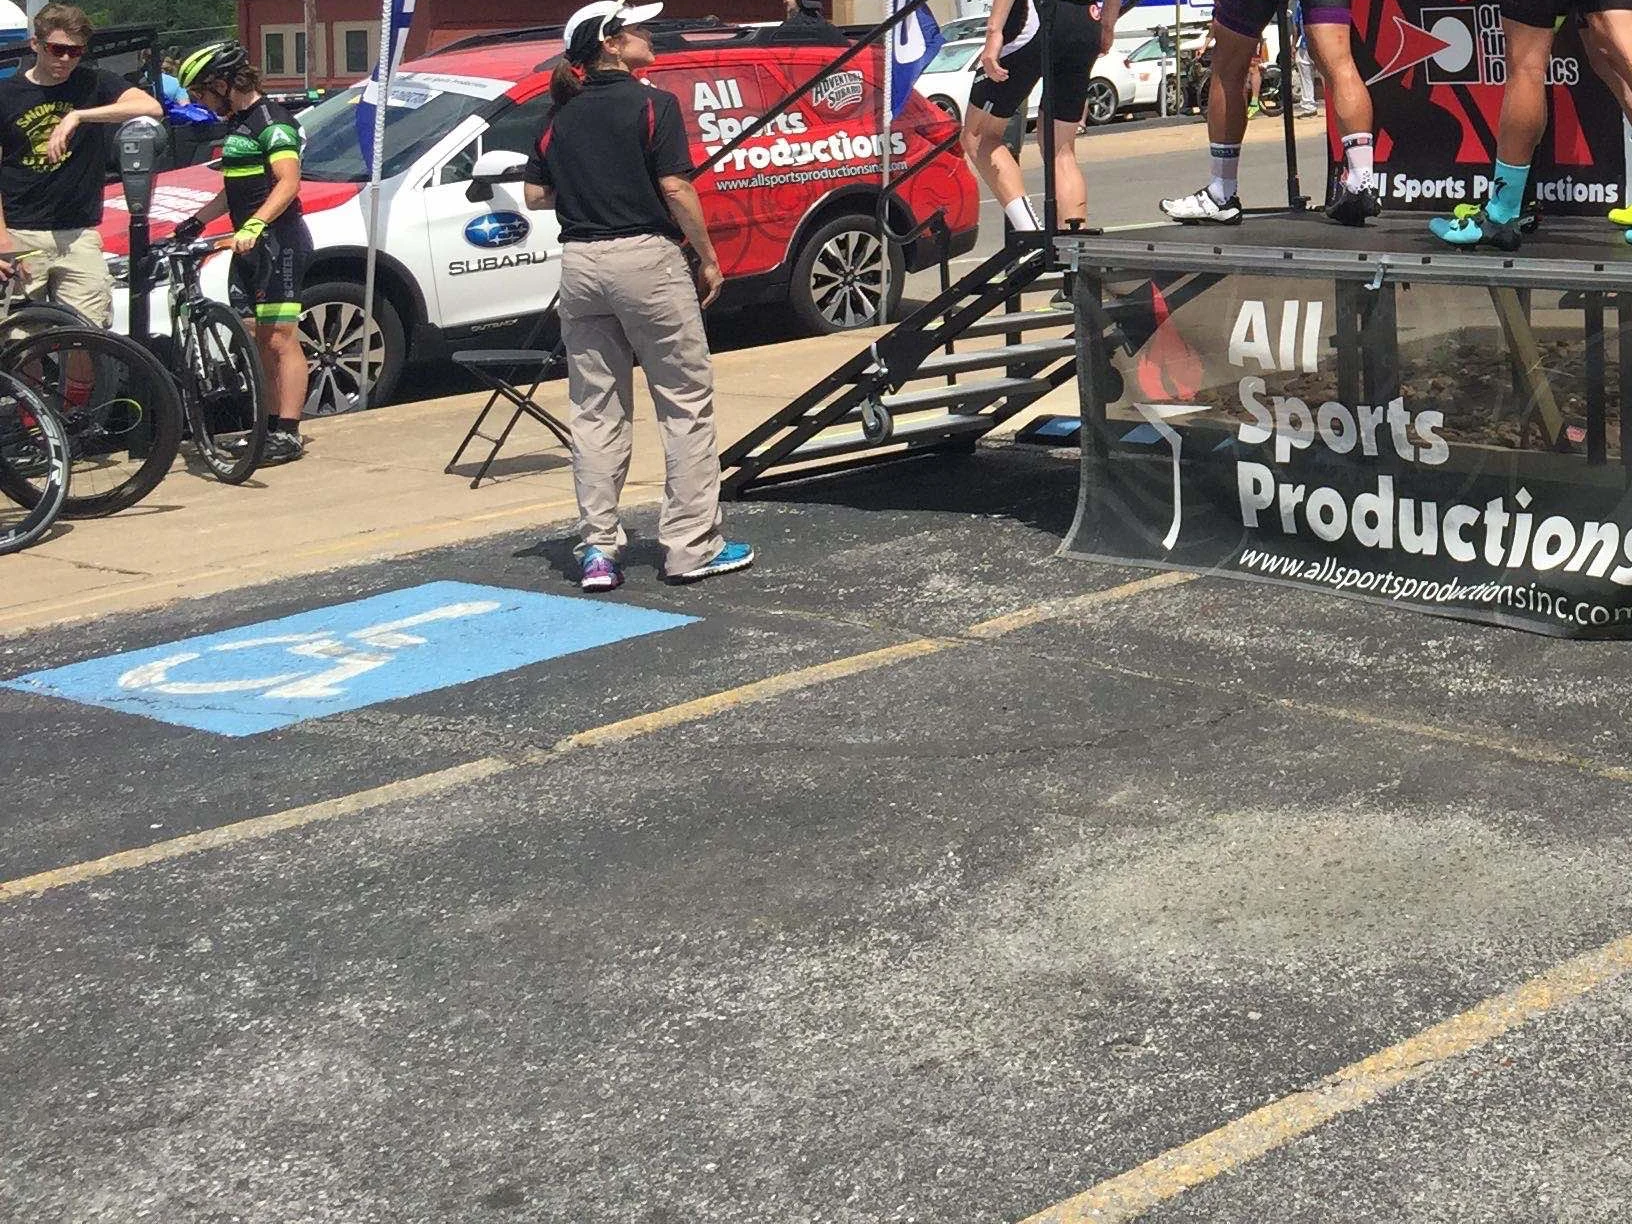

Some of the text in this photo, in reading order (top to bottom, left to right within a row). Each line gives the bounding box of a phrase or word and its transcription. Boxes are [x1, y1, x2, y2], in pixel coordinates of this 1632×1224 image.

[694, 79, 743, 111] All
[1392, 173, 1466, 203] Sports
[448, 250, 548, 276] SUBARU
[1228, 299, 1323, 373] All
[1237, 375, 1450, 465] Sports
